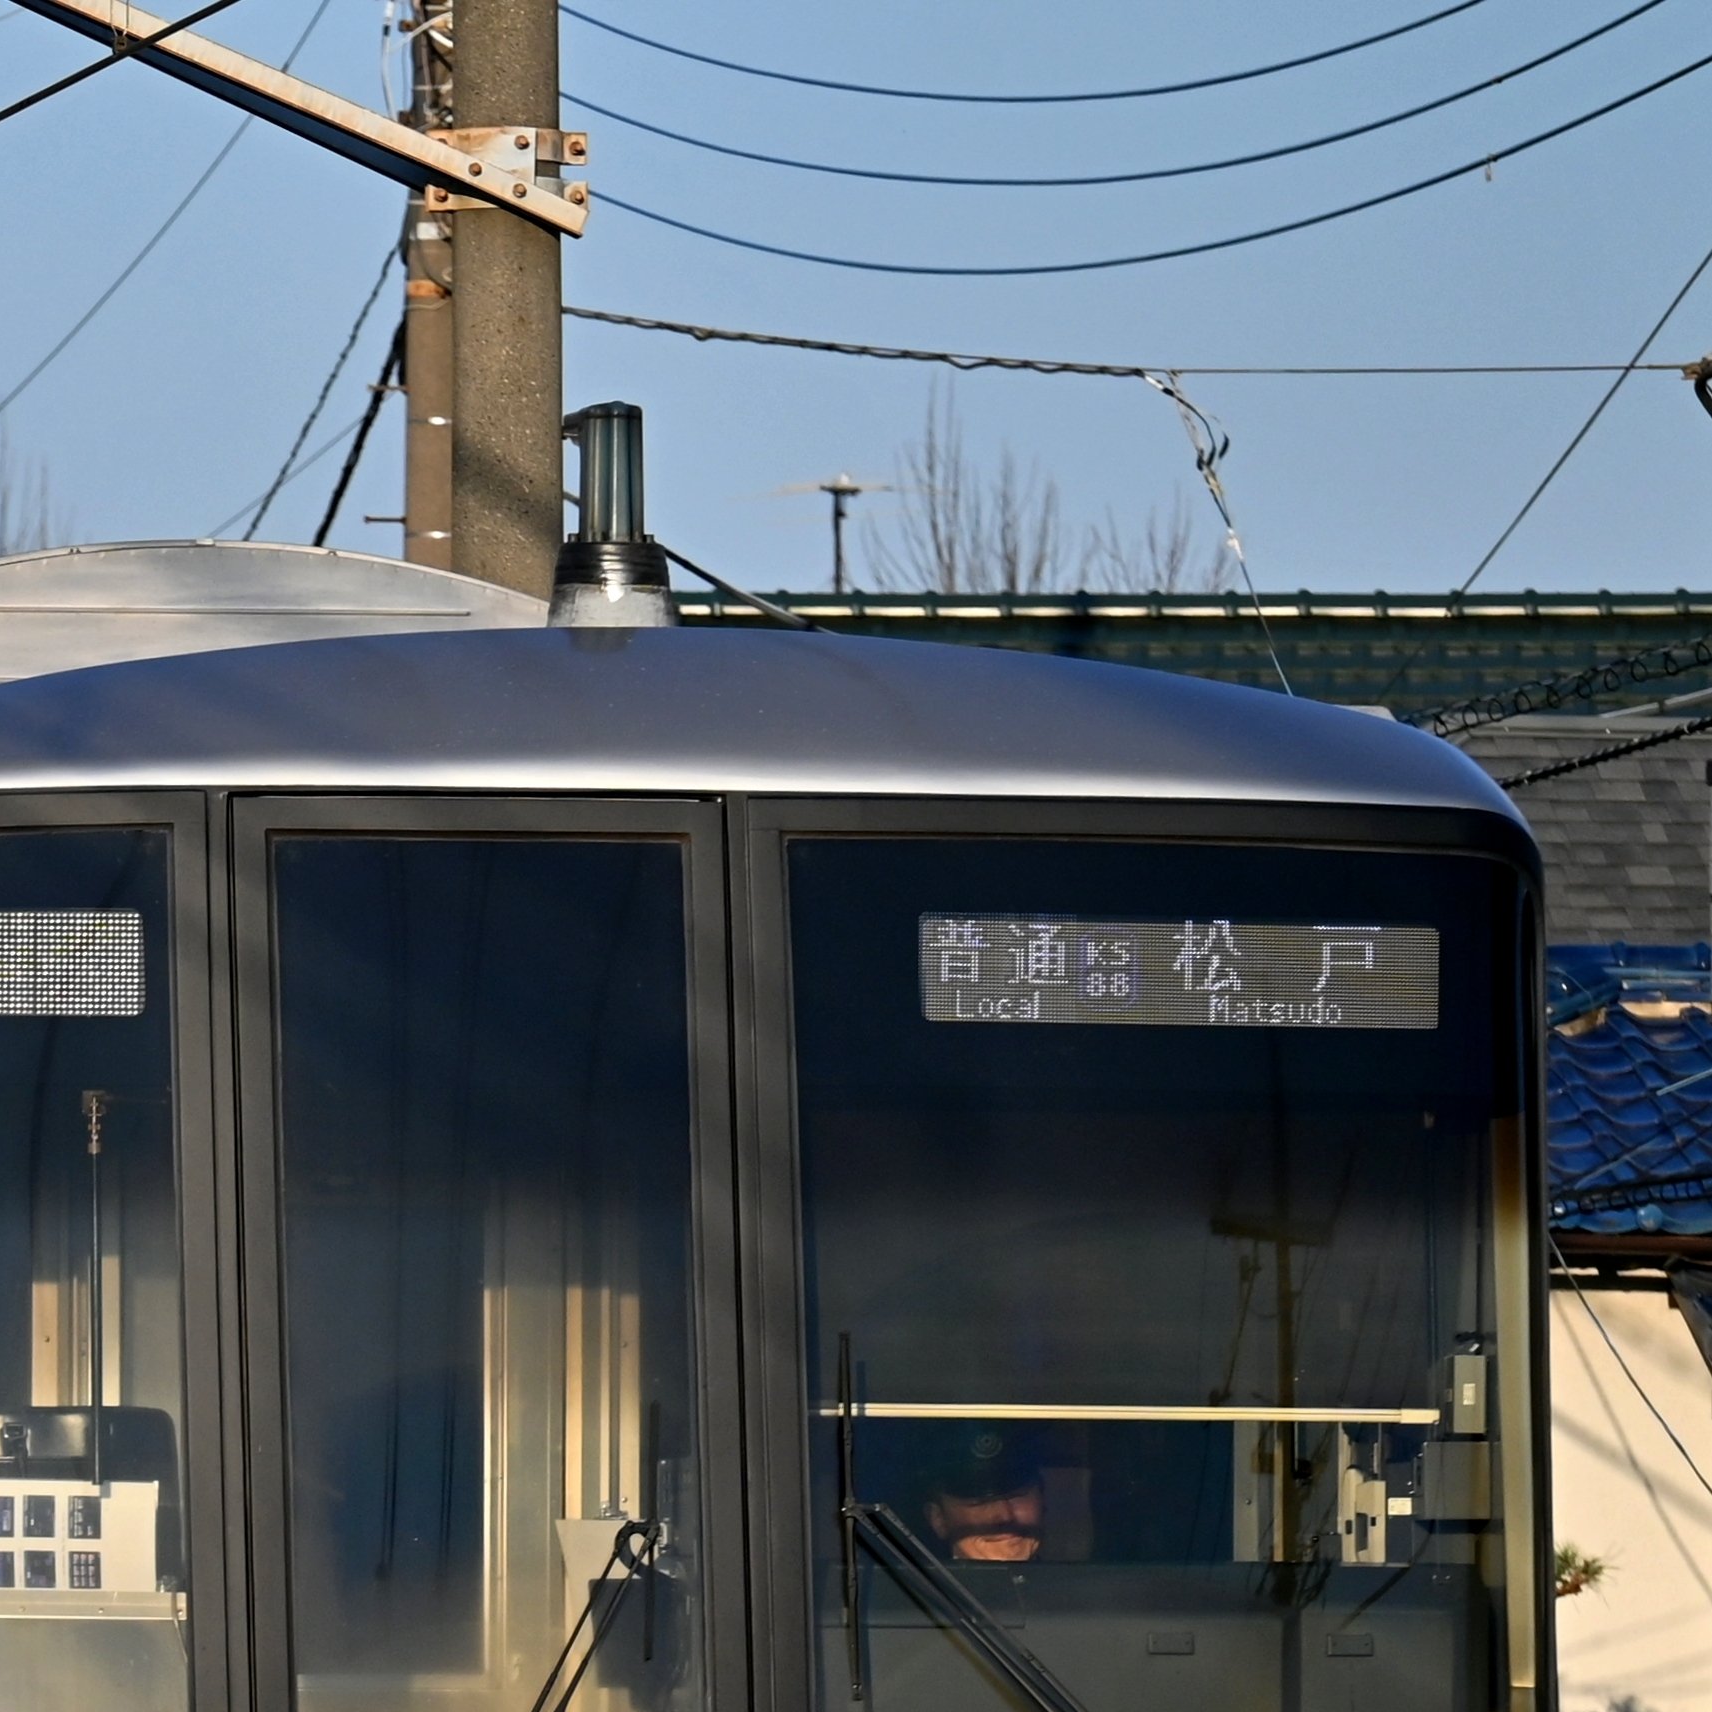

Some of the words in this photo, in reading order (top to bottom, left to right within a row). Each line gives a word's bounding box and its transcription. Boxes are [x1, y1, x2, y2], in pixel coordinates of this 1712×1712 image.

[928, 919, 1070, 984] 普通
[1087, 942, 1130, 965] KS
[1173, 920, 1381, 992] 松戸
[1086, 973, 1129, 996] 88
[956, 990, 1039, 1019] Local
[1209, 994, 1341, 1023] Matsudo
